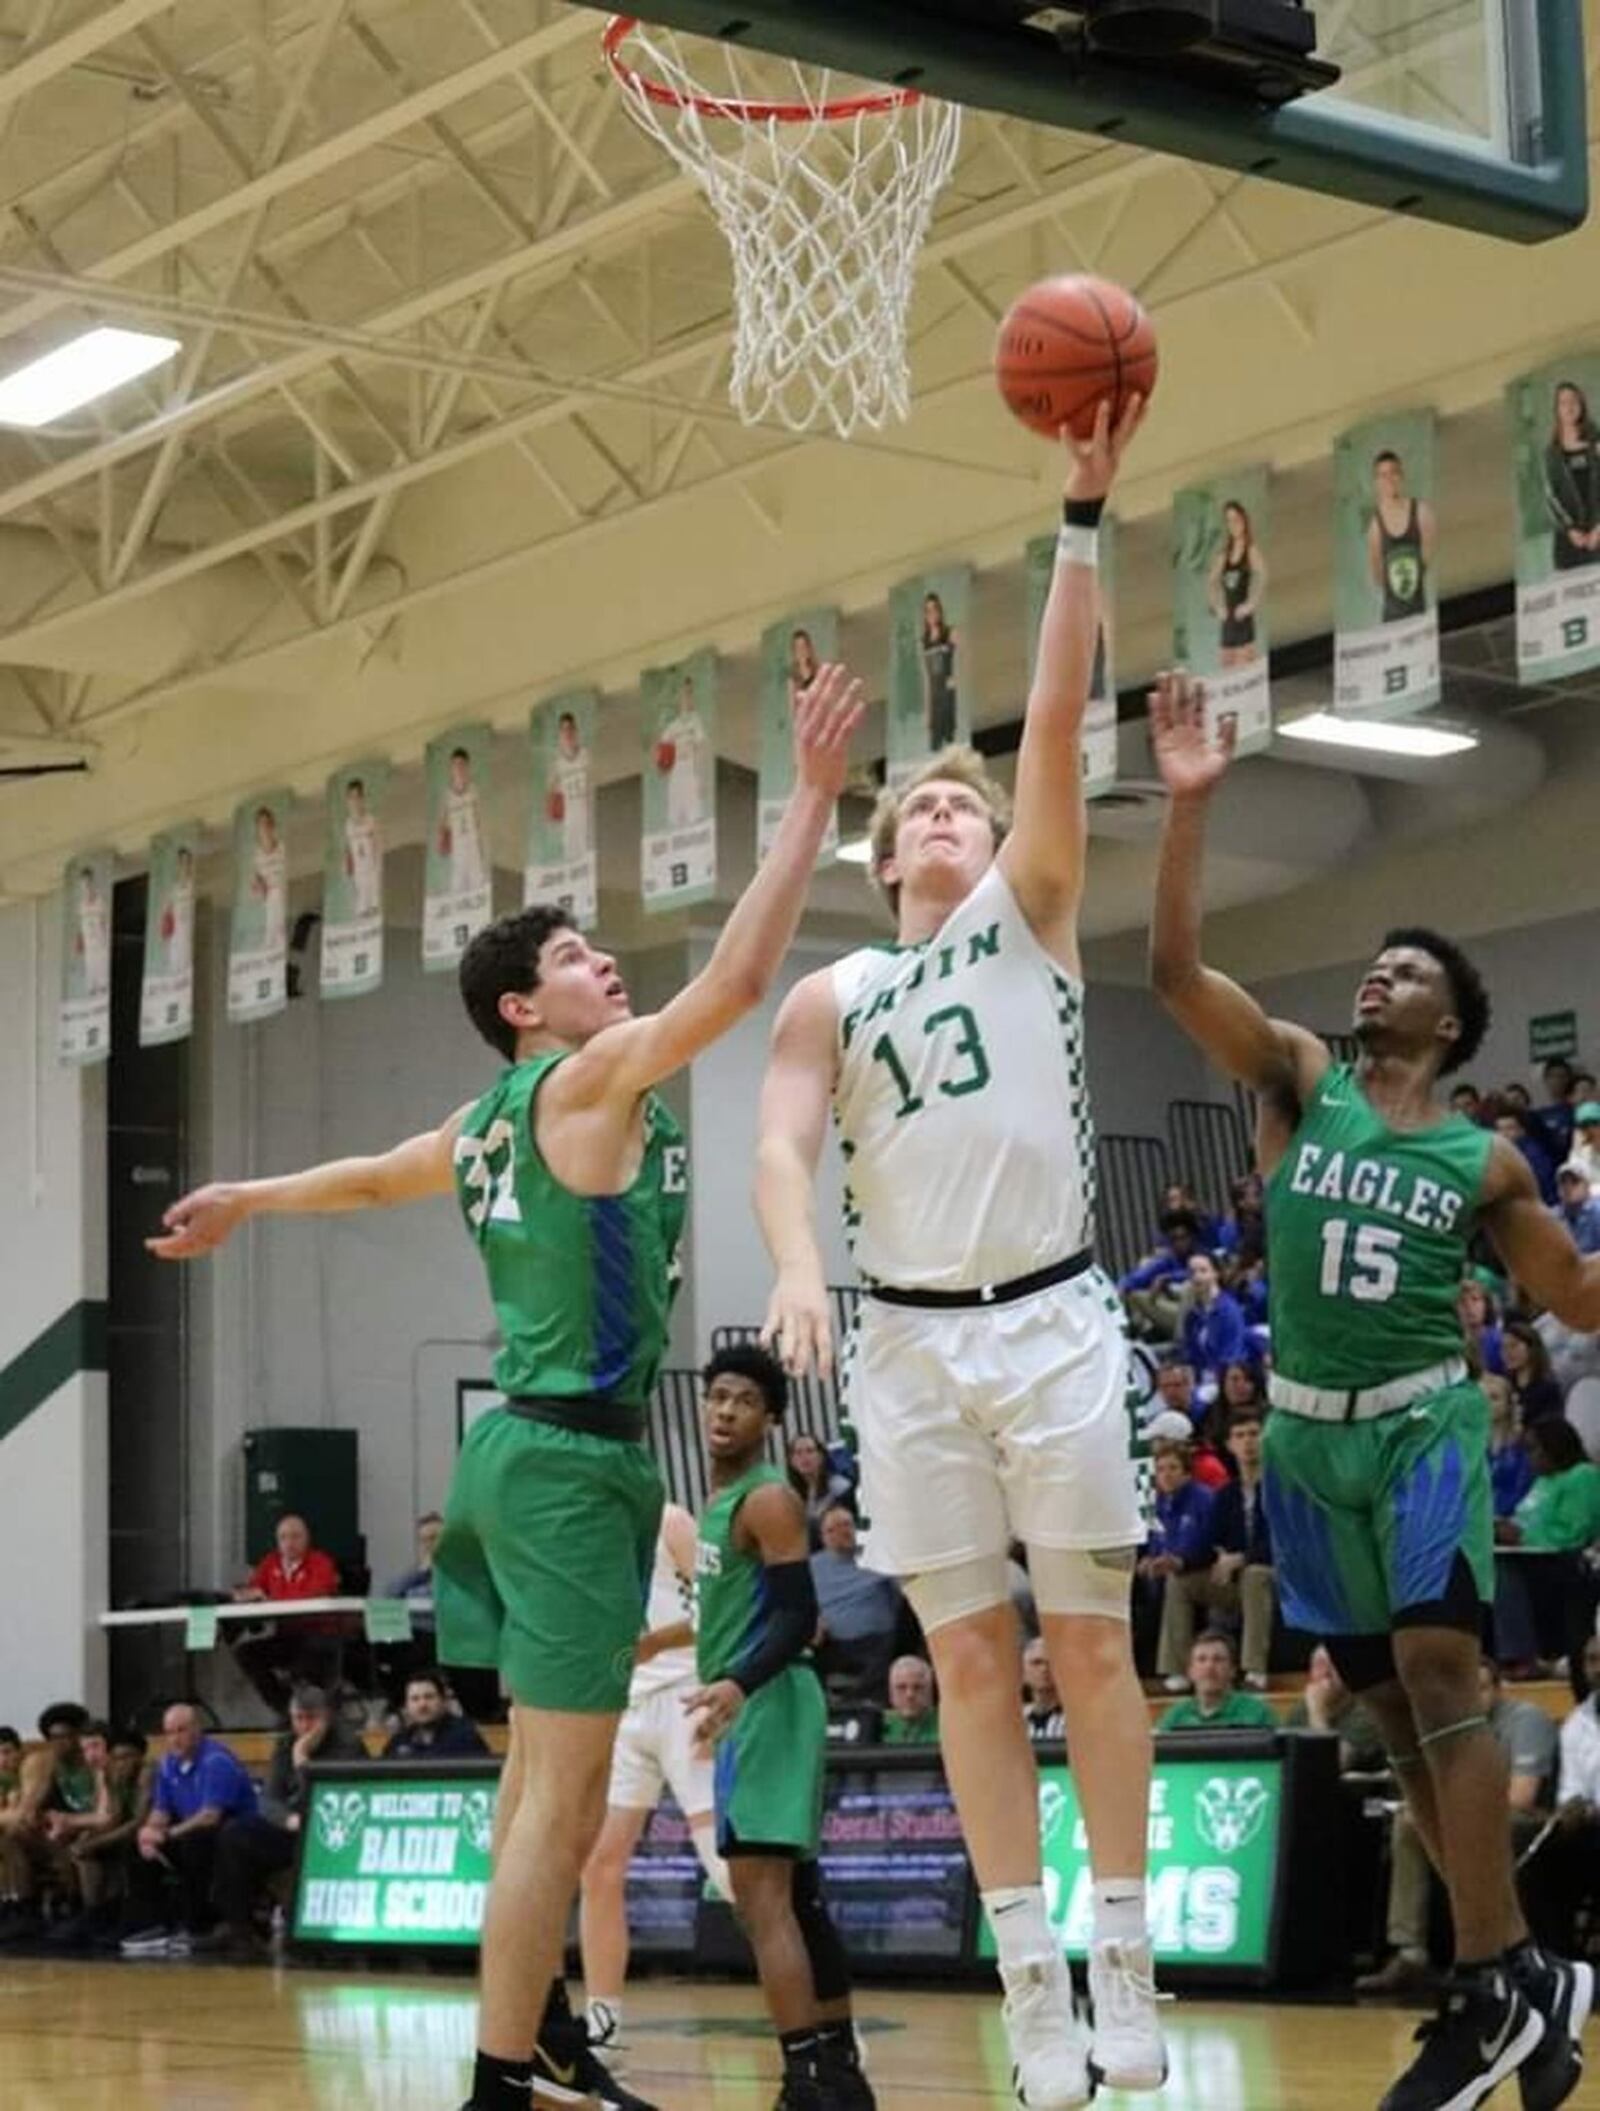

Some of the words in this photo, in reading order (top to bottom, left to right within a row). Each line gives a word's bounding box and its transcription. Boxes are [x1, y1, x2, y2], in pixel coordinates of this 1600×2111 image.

[1560, 616, 1587, 648] B
[1384, 665, 1408, 695] B
[873, 1003, 990, 1118] 13
[454, 1119, 522, 1224] 32
[1290, 1143, 1463, 1234] EAGLES
[1320, 1217, 1403, 1302] 15
[370, 1792, 440, 1819] WELCOME
[442, 1792, 464, 1819] TO
[357, 1825, 460, 1875] BADIN
[301, 1878, 379, 1928] HIGH
[381, 1878, 488, 1930] SCHOO
